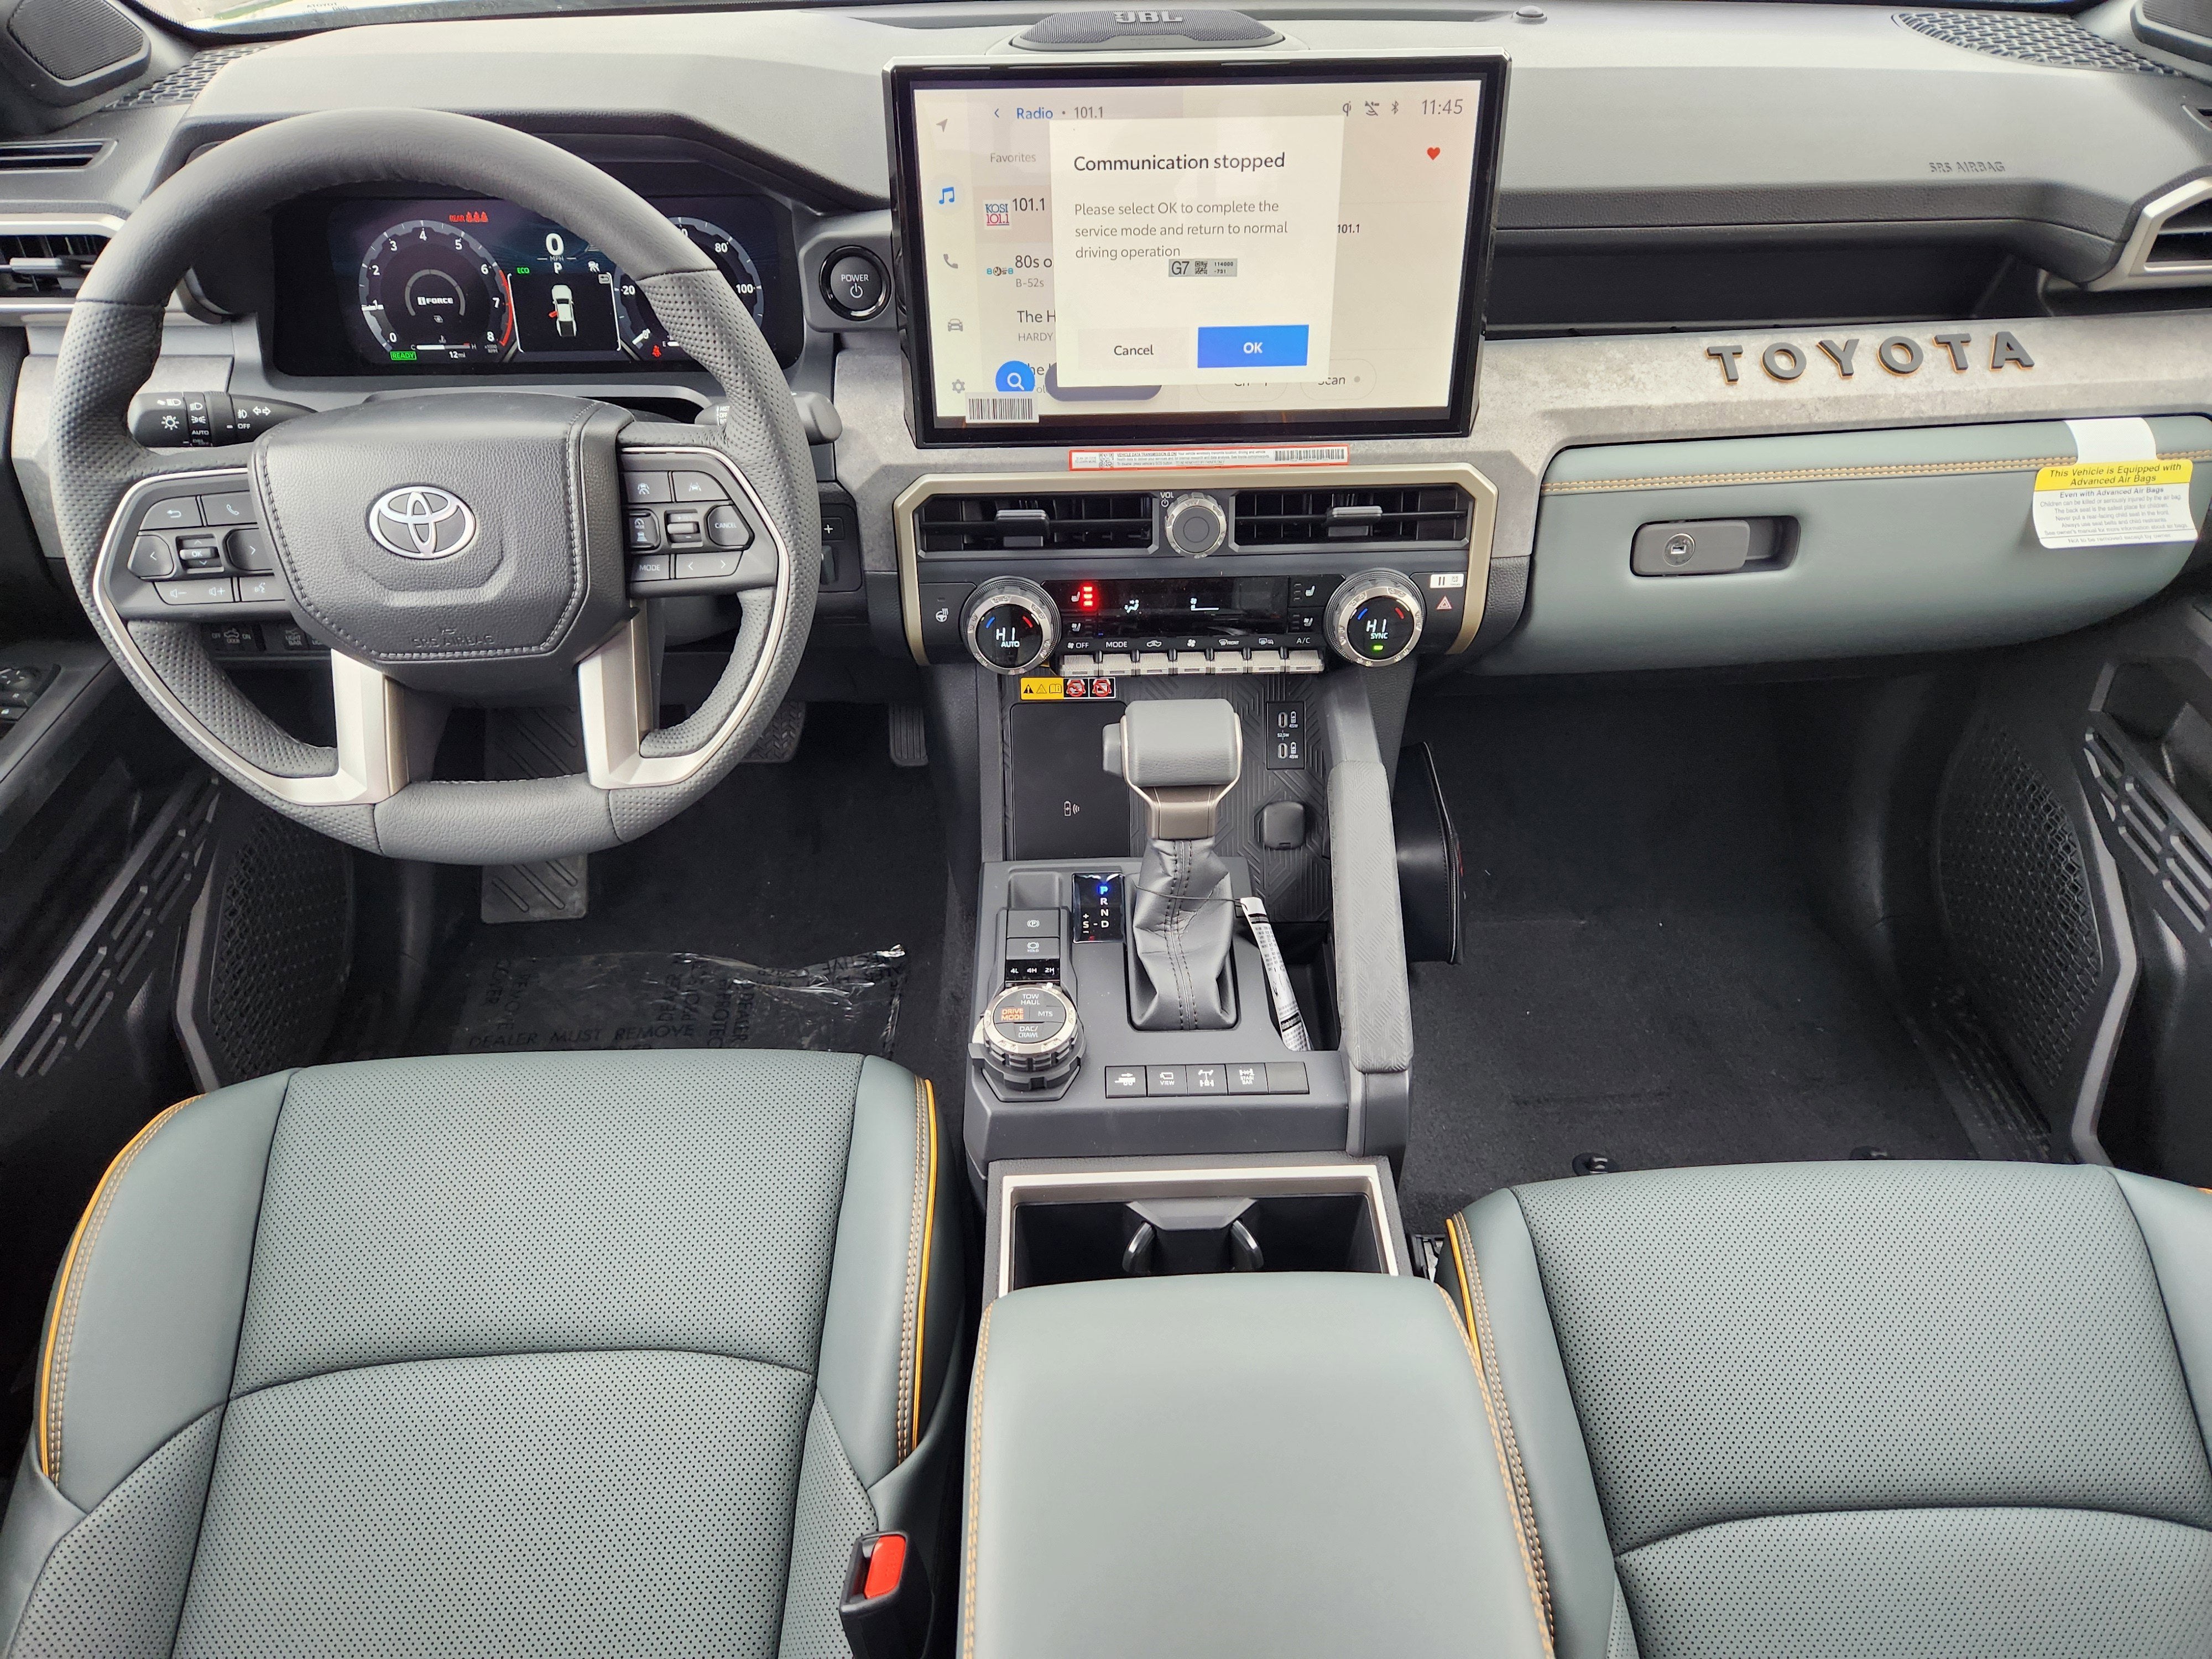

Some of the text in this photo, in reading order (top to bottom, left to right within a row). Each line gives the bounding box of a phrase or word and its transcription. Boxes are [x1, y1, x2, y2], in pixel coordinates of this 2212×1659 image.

[1113, 11, 1183, 23] JBL
[1422, 98, 1463, 115] 11:45
[1016, 107, 1104, 119] Radio 101.1
[990, 153, 1036, 163] Favorites
[1074, 152, 1285, 172] Communication stopped
[1929, 161, 2006, 173] SRS AIRBAG
[985, 204, 1009, 213] KOSI
[1012, 197, 1046, 212] 101.1
[1075, 201, 1280, 216] Please select OK to complete the
[986, 213, 1010, 223] 101.1
[1075, 221, 1288, 237] service mode and return to normal
[1337, 223, 1360, 233] 101.1
[420, 230, 427, 241] 4
[390, 241, 398, 251] 3
[455, 239, 462, 250] 5
[546, 233, 564, 256] 0
[714, 242, 728, 253] 80
[1076, 246, 1181, 259] driving operation
[1015, 255, 1040, 268] 80s
[372, 265, 380, 275] 2
[481, 264, 488, 274] 6
[554, 262, 563, 274] P
[1171, 260, 1190, 275] G7
[841, 274, 869, 282] POWER
[1016, 278, 1044, 288] B-52s
[622, 285, 635, 295] 20
[736, 284, 754, 294] 100
[373, 299, 378, 309] 1
[492, 297, 500, 308] 7
[1017, 310, 1043, 323] The
[389, 332, 397, 342] 0
[487, 331, 495, 342] 8
[643, 330, 649, 339] 0
[1018, 332, 1053, 342] HARDY
[1114, 344, 1154, 356] Cancel
[1243, 342, 1263, 353] OK
[1706, 331, 2035, 383] TOYOTA
[2072, 468, 2104, 476] Vehicle
[2117, 464, 2160, 477] Equipped
[2163, 463, 2182, 471] with
[2070, 476, 2115, 486] Advanced
[2134, 474, 2156, 484] Bags
[1366, 619, 1386, 632] HI
[996, 627, 1015, 640] HI
[1100, 886, 1108, 895] P
